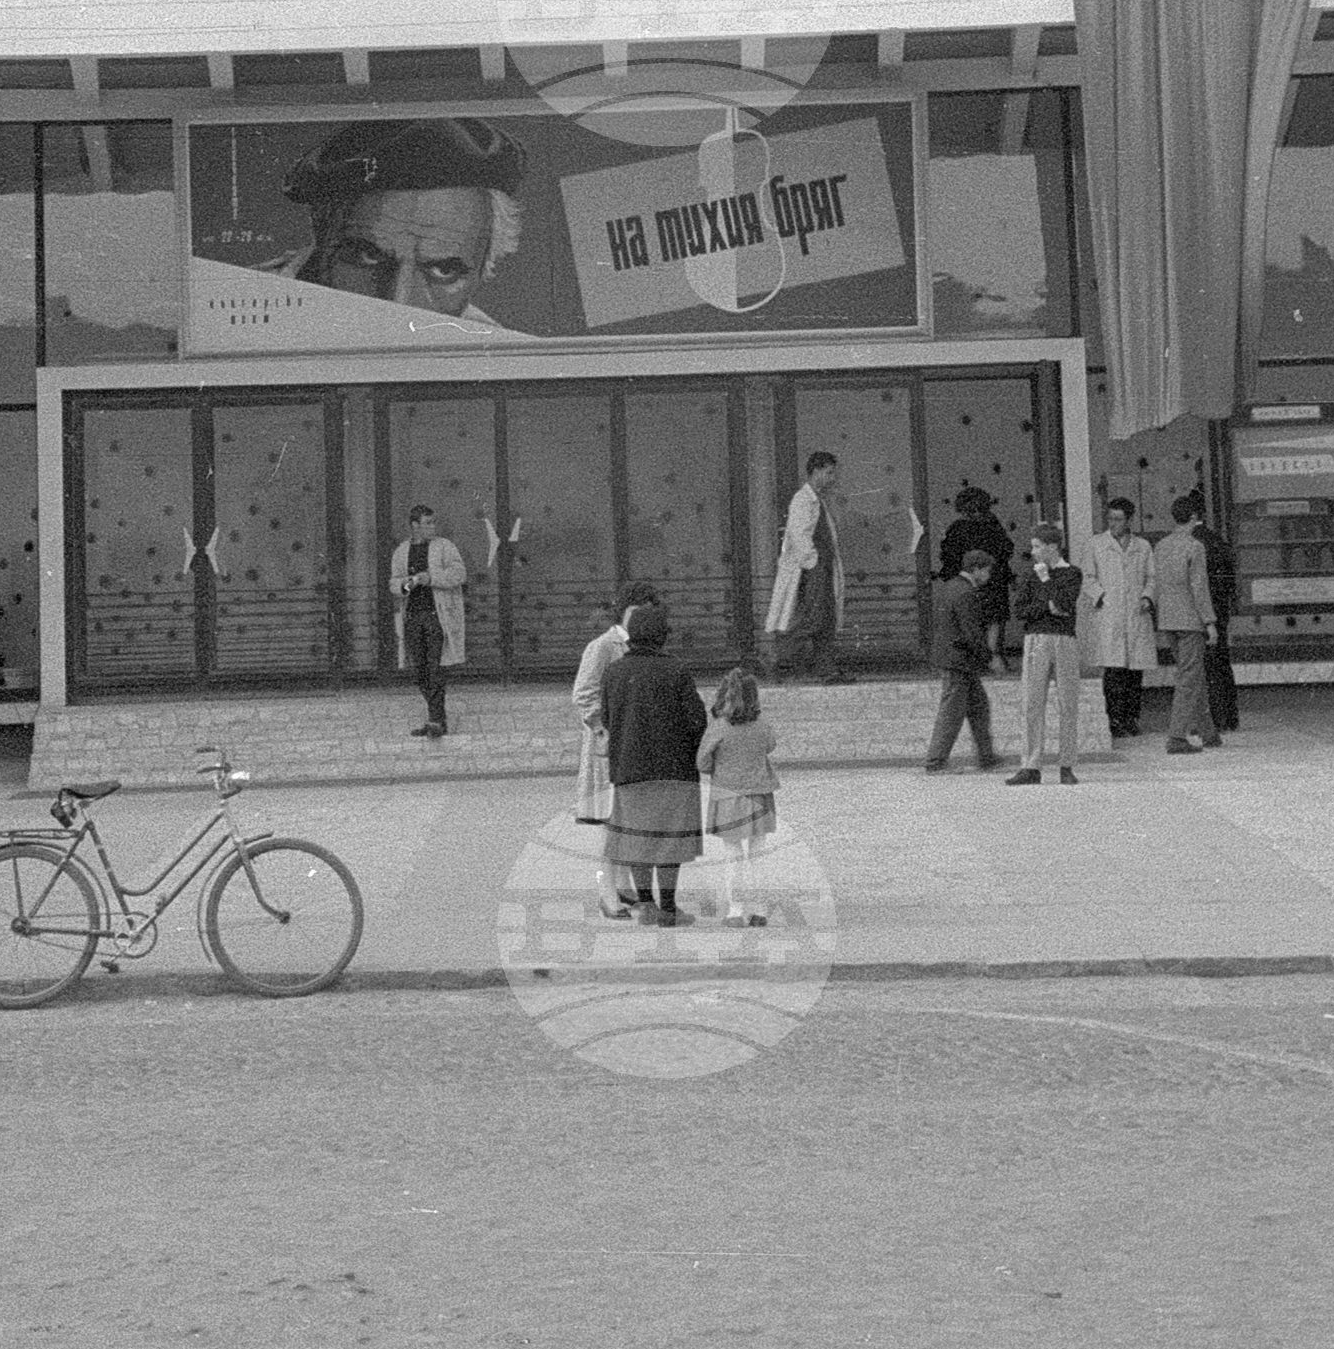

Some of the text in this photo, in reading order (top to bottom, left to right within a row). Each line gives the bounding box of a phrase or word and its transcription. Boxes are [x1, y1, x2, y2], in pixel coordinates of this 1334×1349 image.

[605, 173, 848, 271] на тихия бряг
